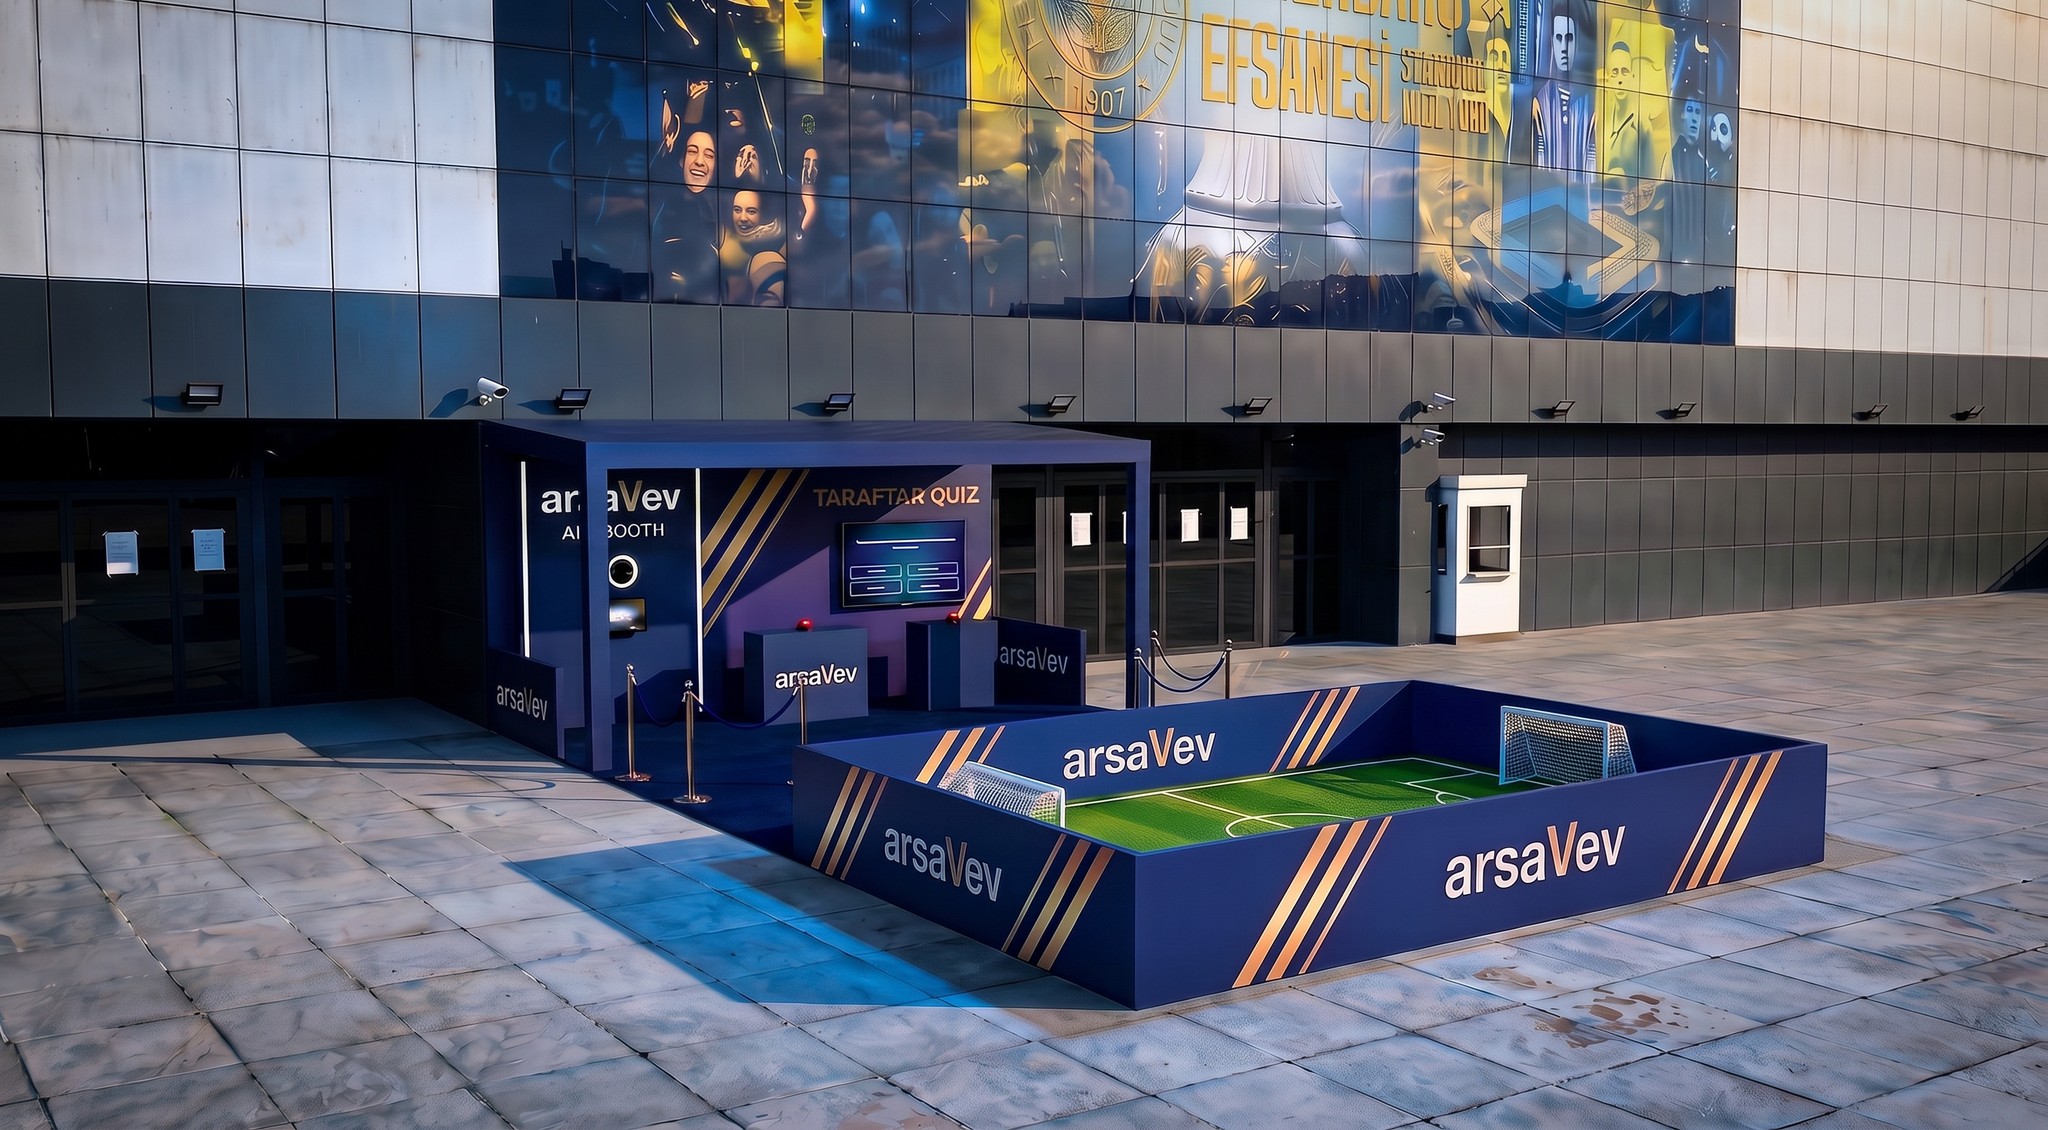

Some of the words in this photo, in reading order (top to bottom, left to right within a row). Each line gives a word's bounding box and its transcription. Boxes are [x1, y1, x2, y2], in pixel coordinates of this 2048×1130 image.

[1202, 13, 1391, 123] EFSANESİ
[1072, 86, 1126, 117] 1907
[541, 480, 681, 514] araVev
[813, 486, 925, 507] TARAFTAR
[930, 485, 980, 507] QUIZ
[775, 663, 858, 689] arsaVev
[1000, 646, 1068, 674] arsaVev
[496, 685, 548, 721] arsaVev
[1063, 727, 1216, 780] arsaVev
[884, 826, 1003, 902] arsaVev
[1444, 820, 1626, 899] arsaVev
